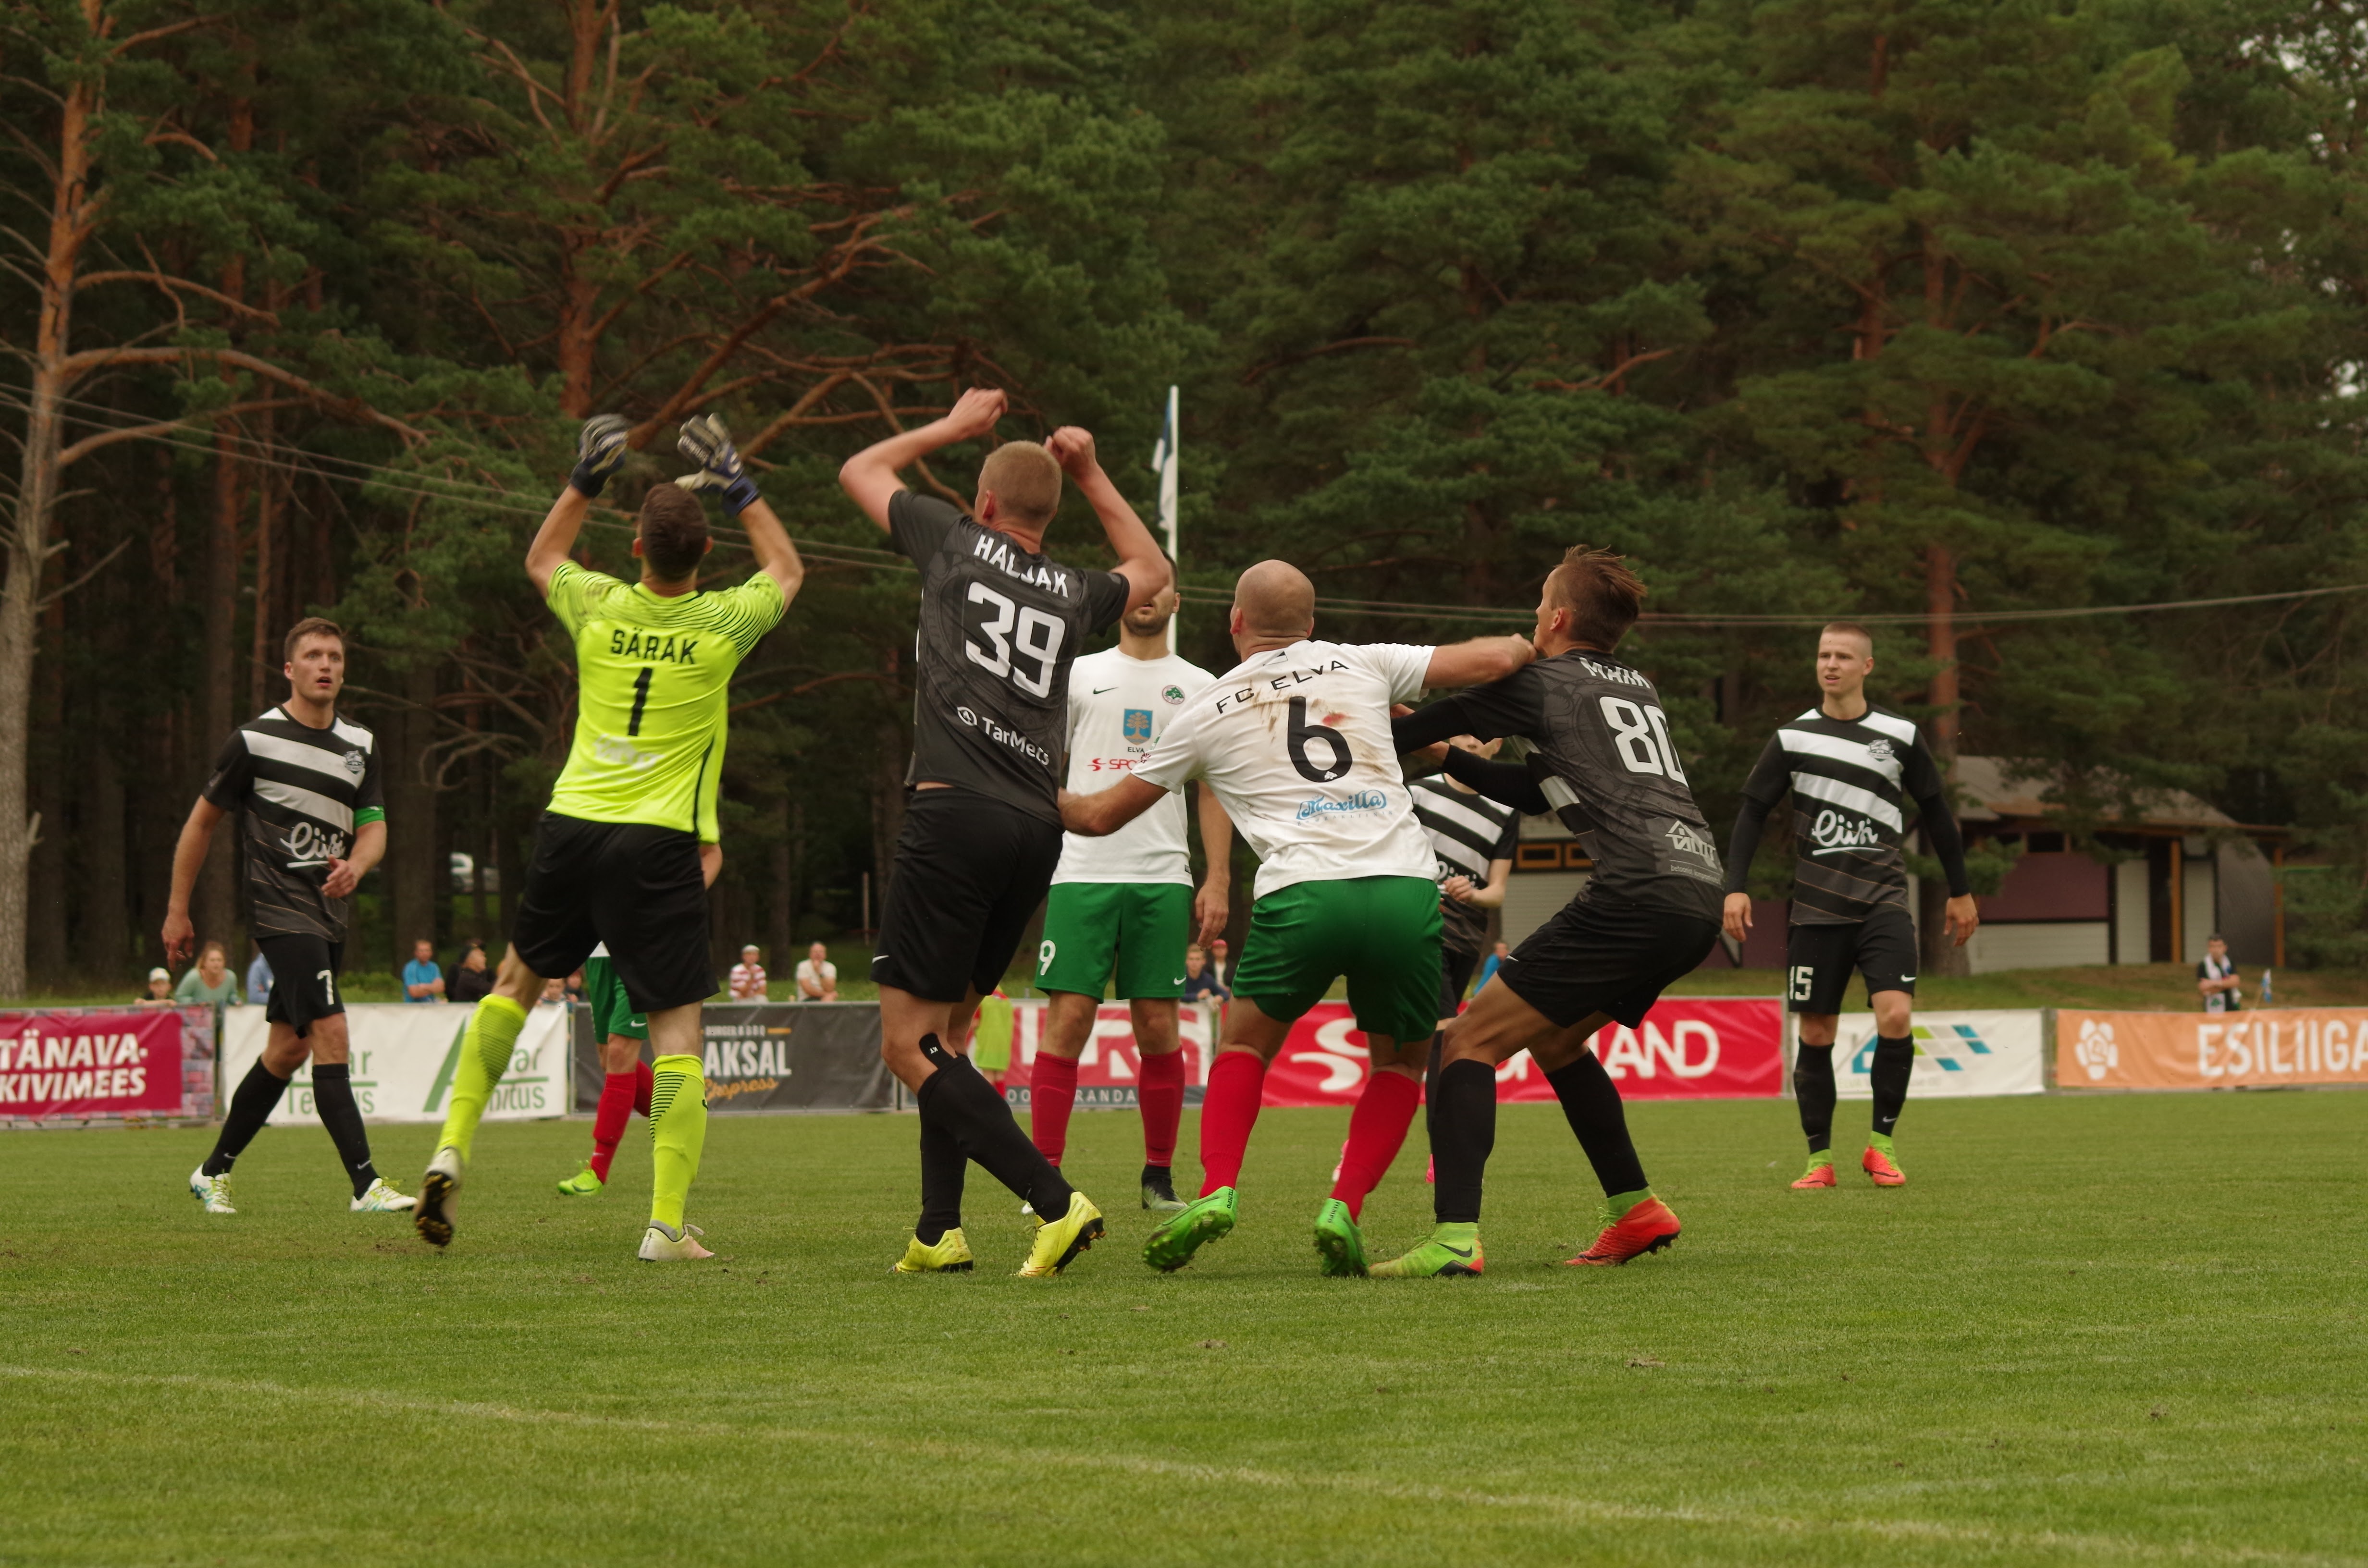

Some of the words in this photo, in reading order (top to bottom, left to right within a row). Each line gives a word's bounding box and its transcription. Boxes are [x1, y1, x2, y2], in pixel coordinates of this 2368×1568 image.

[610, 627, 699, 664] SÄRAK
[966, 581, 1065, 698] 39
[628, 667, 654, 736] 1
[1216, 687, 1255, 714] FC
[1270, 660, 1349, 691] ELVA
[1287, 696, 1353, 783] 6
[1296, 789, 1387, 821] Maxilla
[1039, 940, 1056, 976] 9
[317, 969, 334, 1005] 7
[1789, 966, 1813, 1001] 15
[703, 1040, 792, 1077] AKSAL
[0, 1066, 147, 1103] KIVIMEES
